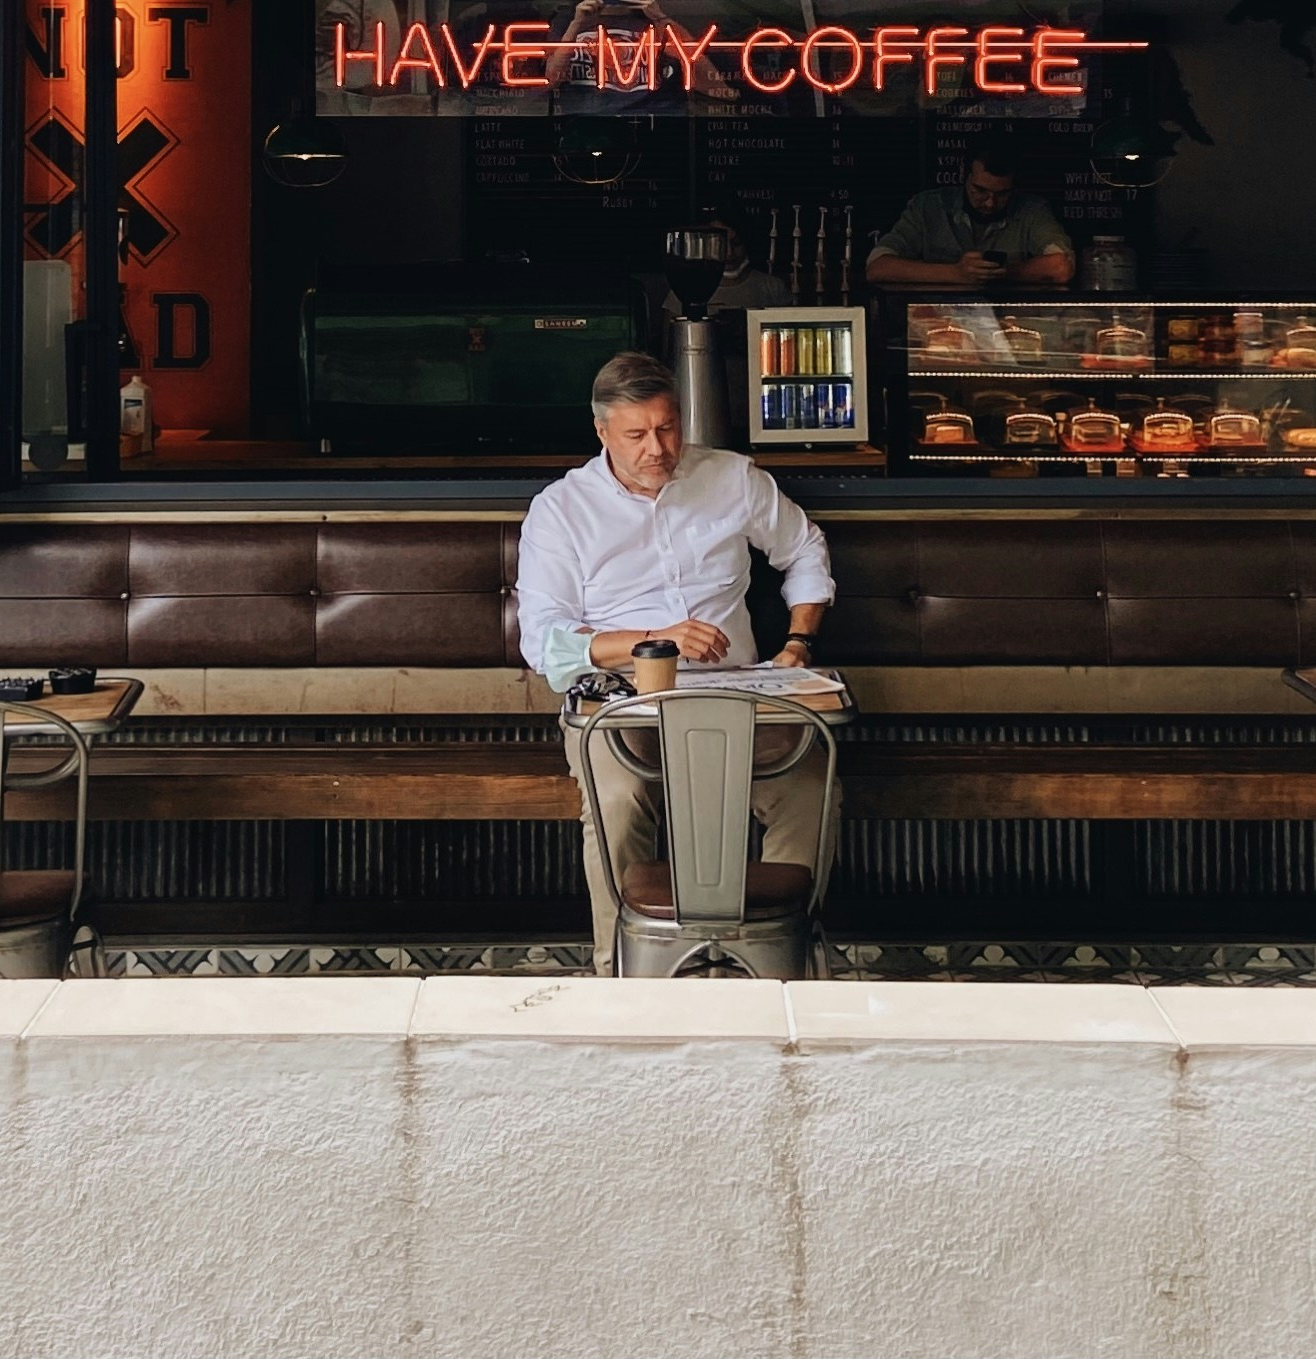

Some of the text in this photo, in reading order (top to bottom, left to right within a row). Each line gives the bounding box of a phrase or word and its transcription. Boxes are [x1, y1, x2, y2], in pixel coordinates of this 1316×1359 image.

[334, 20, 551, 89] HAVE
[594, 23, 719, 91] MY
[741, 23, 1087, 95] COFFEE
[474, 123, 502, 133] LATTE
[732, 122, 749, 132] TEA
[708, 139, 728, 149] HOT
